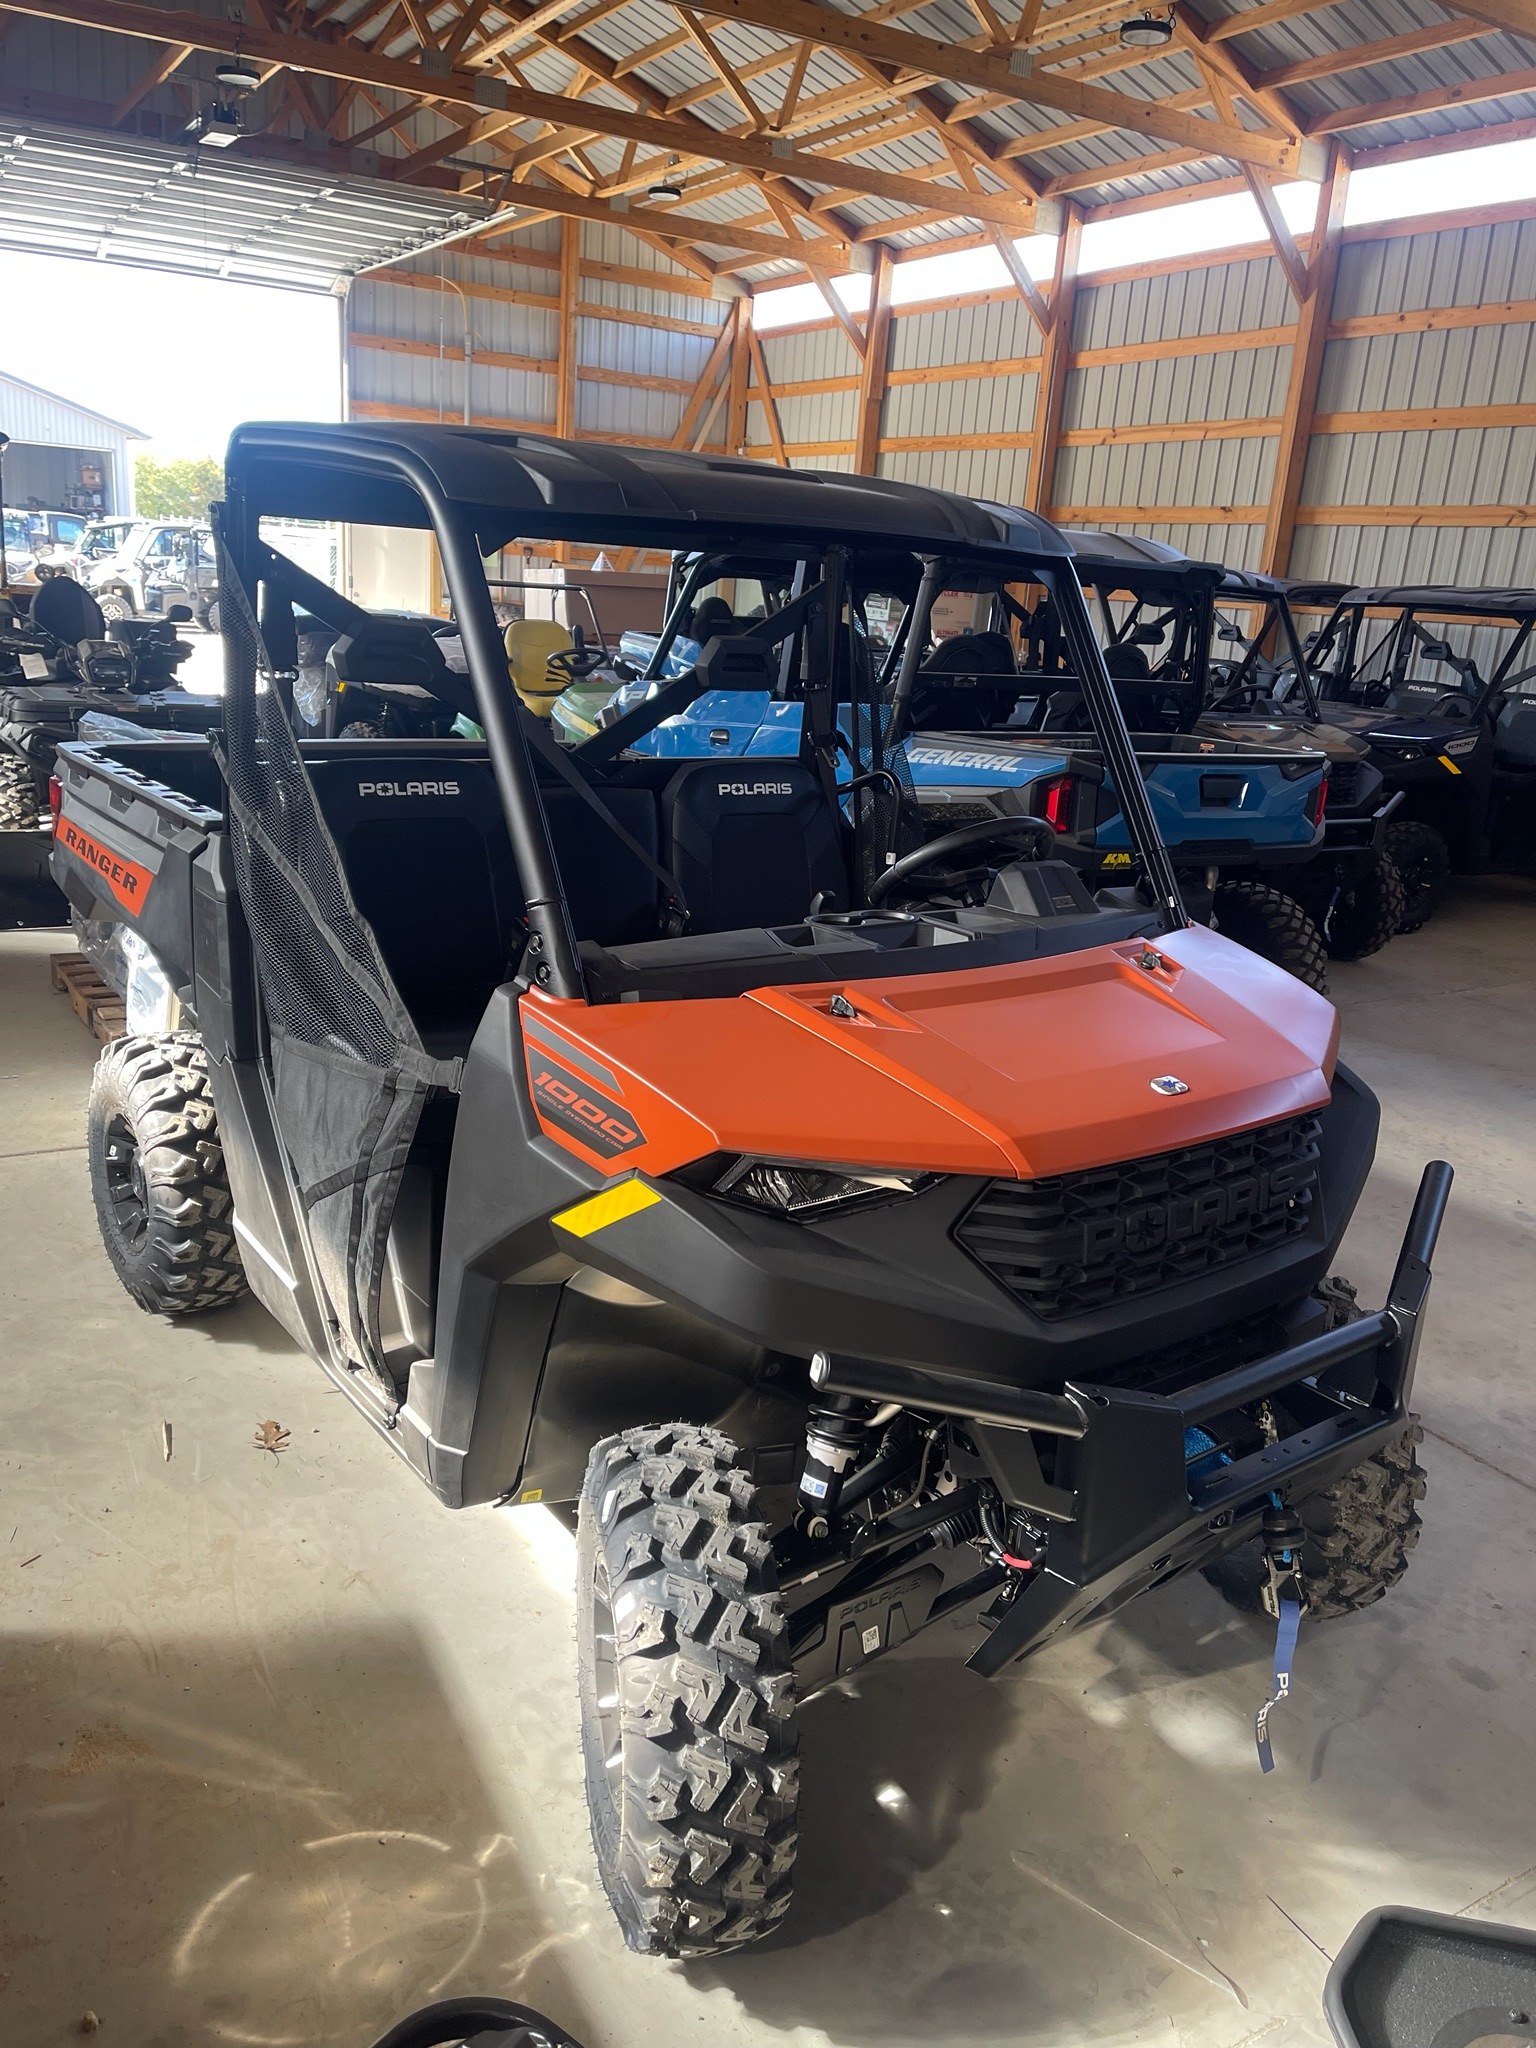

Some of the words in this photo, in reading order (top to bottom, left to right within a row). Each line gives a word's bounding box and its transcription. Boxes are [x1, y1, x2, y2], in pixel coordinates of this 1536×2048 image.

[1408, 685, 1437, 693] POLARIS
[908, 747, 1023, 773] GENERAL
[1448, 741, 1475, 750] 1000
[358, 781, 460, 797] POLARIS
[718, 783, 792, 796] POLARIS
[65, 827, 138, 895] RANGER
[534, 1071, 637, 1144] 1000
[536, 1090, 564, 1111] SINGLE
[565, 1110, 606, 1138] OVERHEAD
[605, 1137, 624, 1151] CAM
[1081, 1167, 1296, 1265] POLARIS
[839, 1577, 923, 1620] POLARIS
